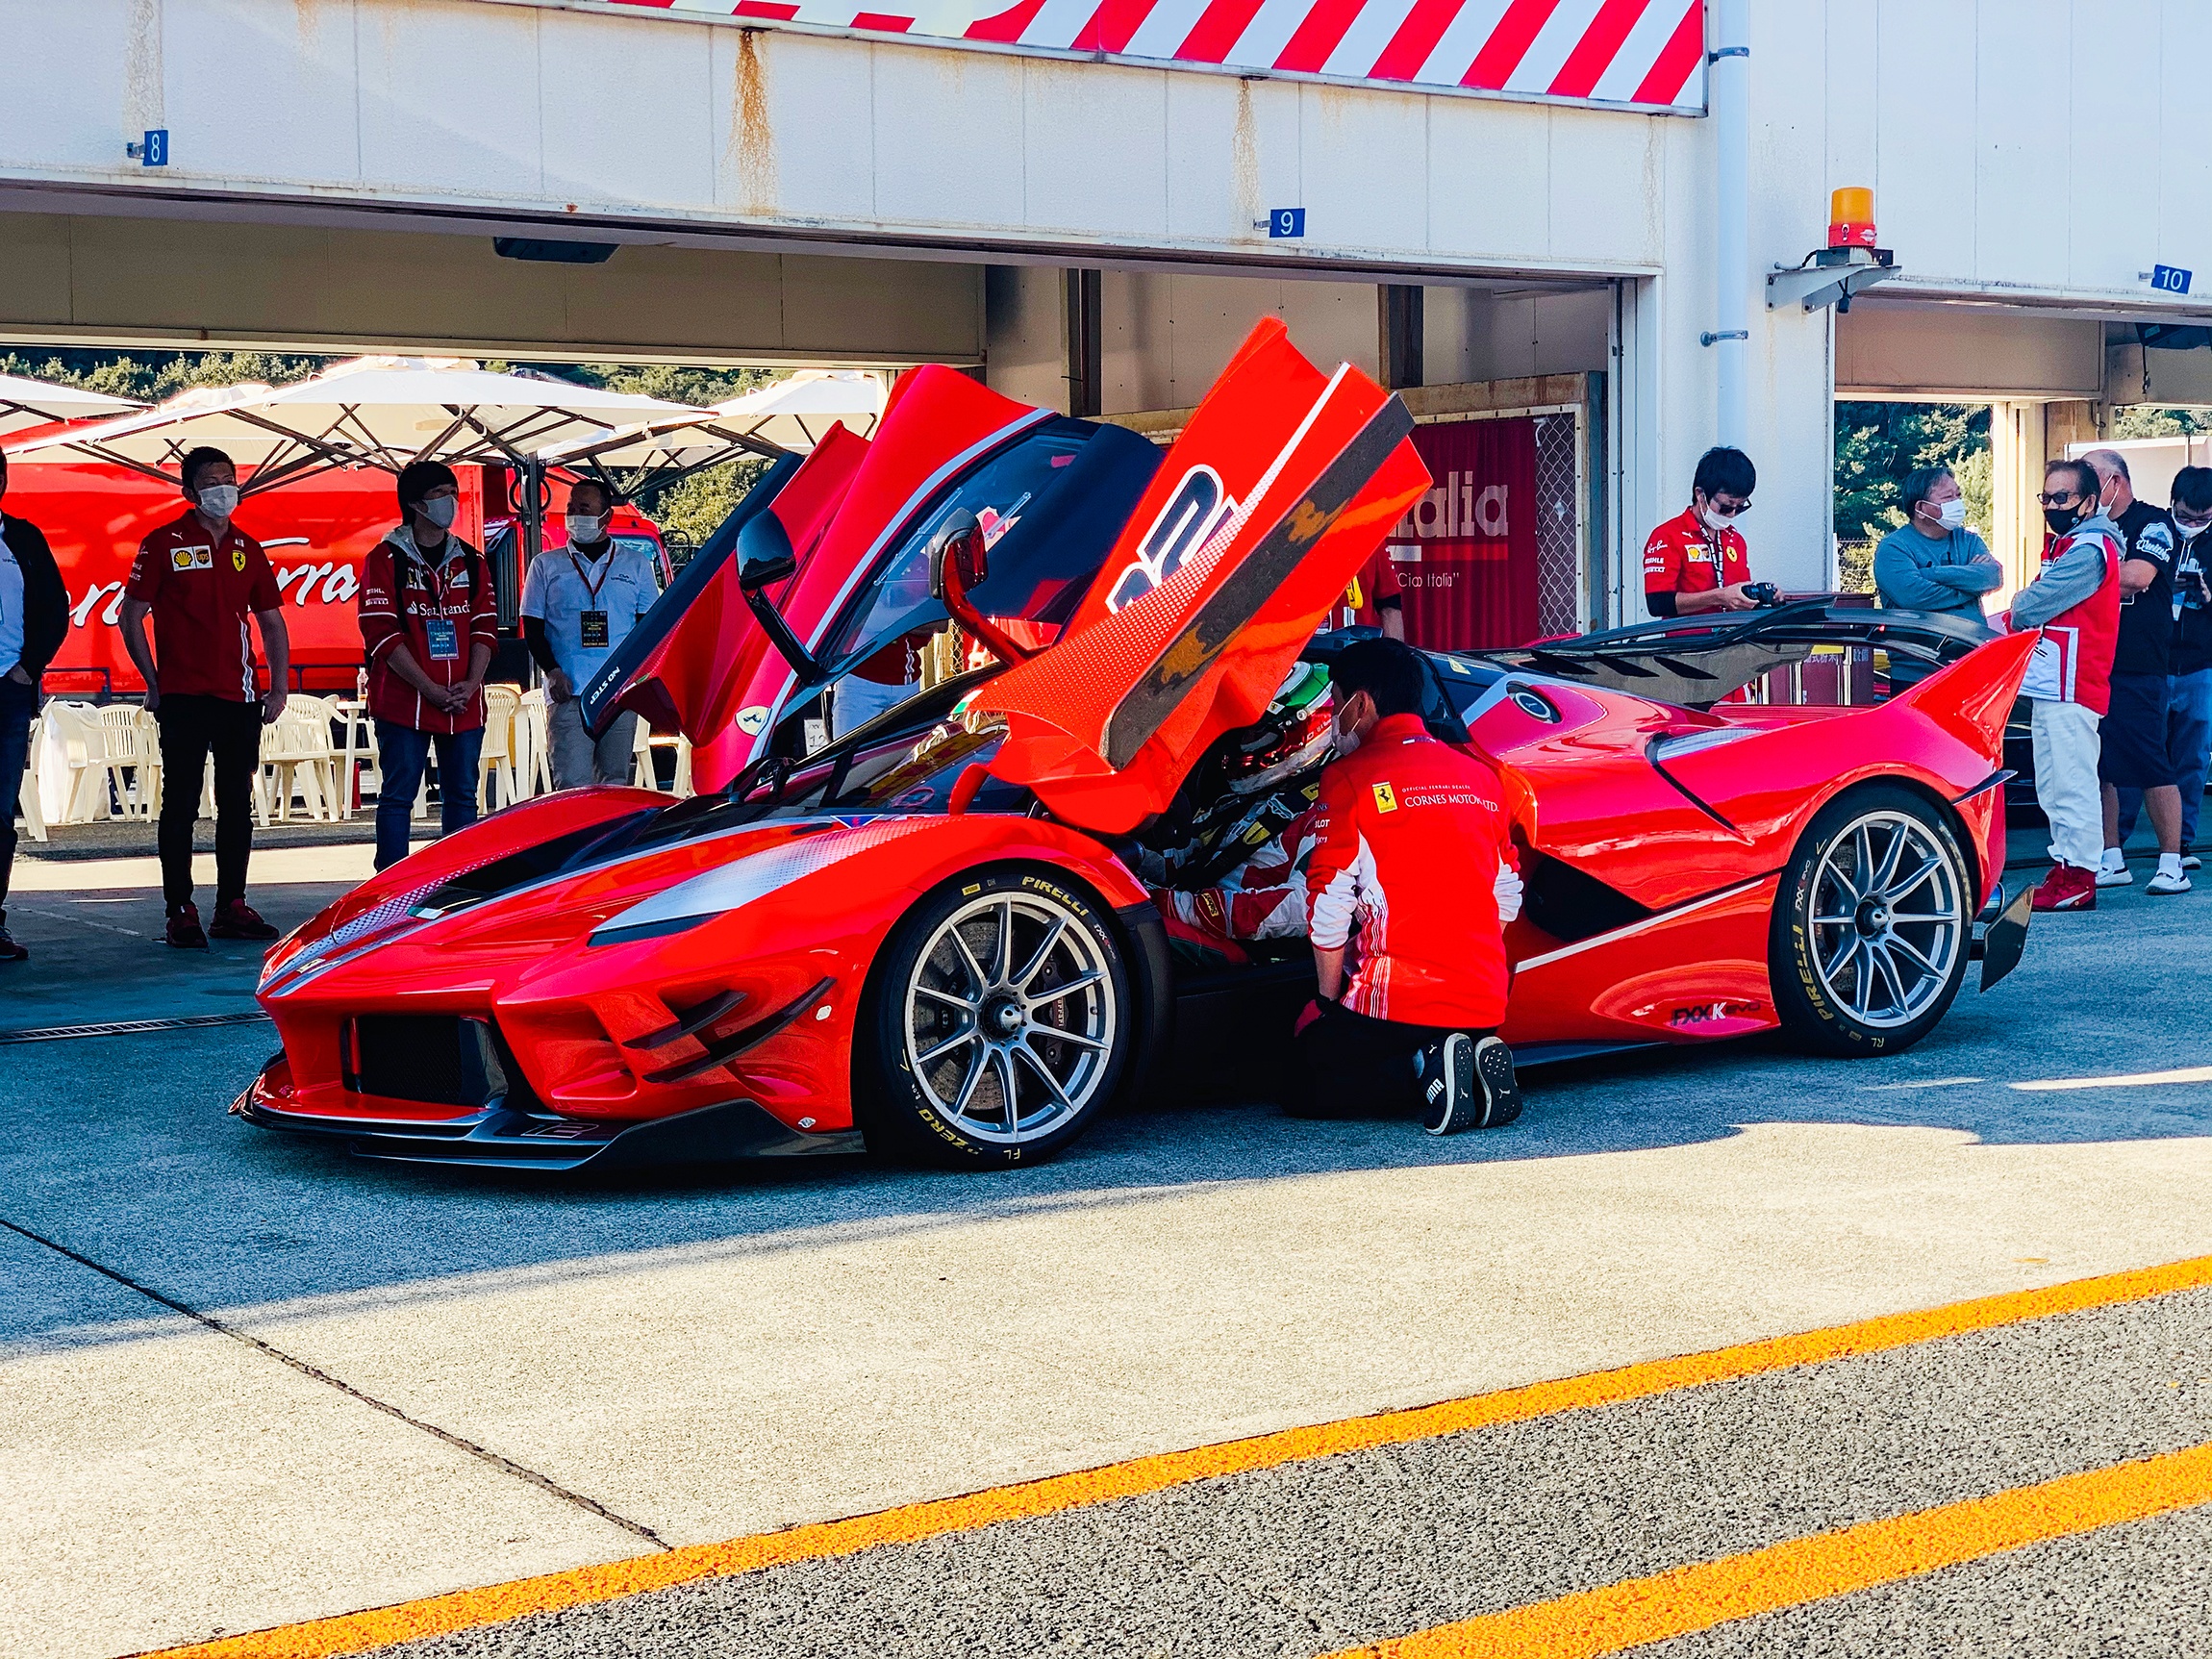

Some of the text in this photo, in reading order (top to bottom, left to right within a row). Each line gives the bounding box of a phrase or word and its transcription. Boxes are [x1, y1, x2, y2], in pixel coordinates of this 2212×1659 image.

[151, 133, 161, 163] 8
[1280, 211, 1295, 236] 9
[2161, 268, 2183, 290] 10
[1386, 470, 1509, 539] alia
[590, 666, 621, 705] NO STEP
[1404, 793, 1447, 809] CORNES
[1021, 876, 1090, 917] PIRELLI
[1792, 923, 1835, 1021] PIRELLI
[1871, 1037, 1885, 1048] RL
[917, 1108, 969, 1150] ZERO
[1003, 1147, 1021, 1160] FL
